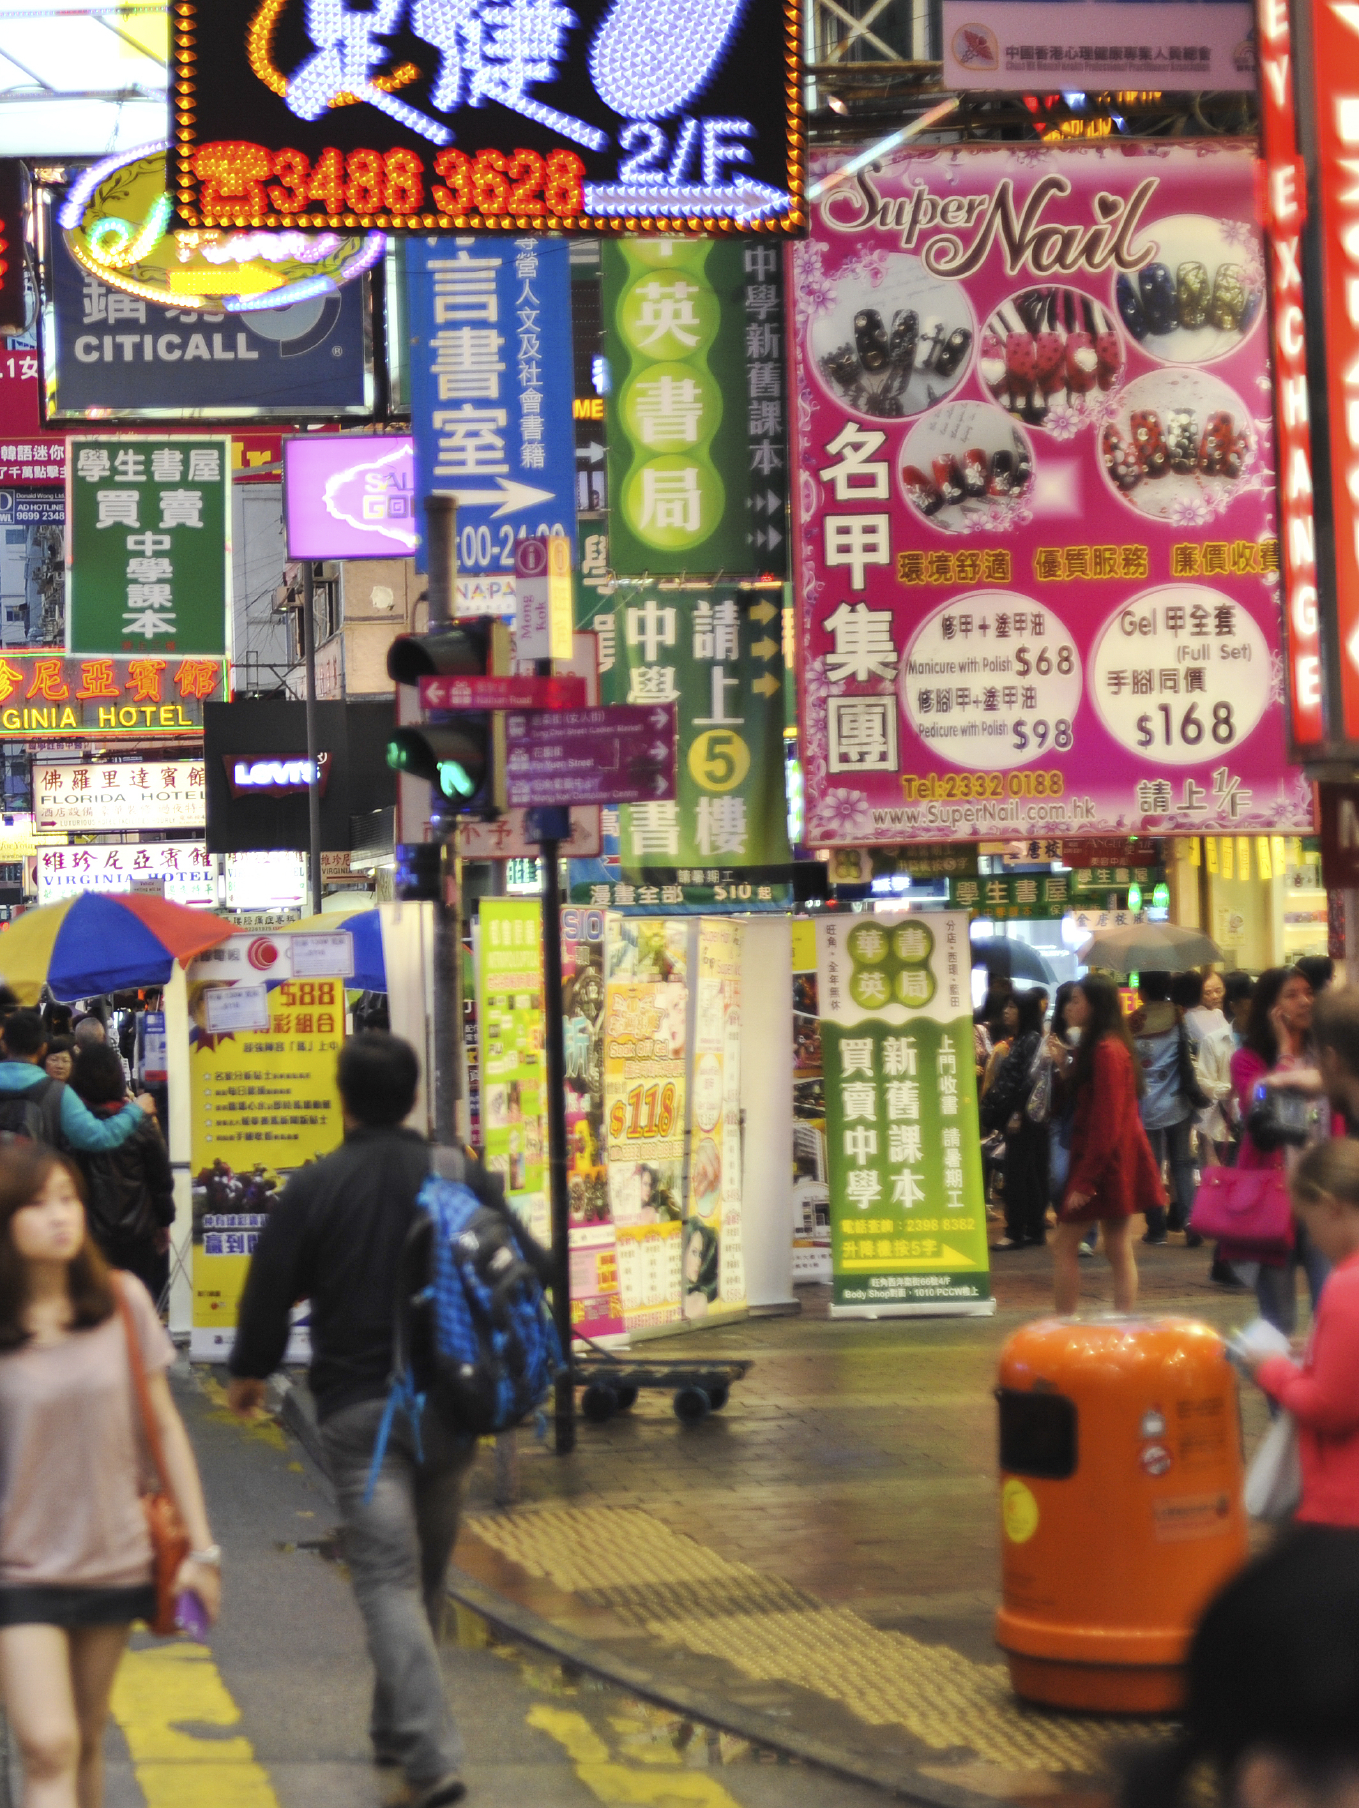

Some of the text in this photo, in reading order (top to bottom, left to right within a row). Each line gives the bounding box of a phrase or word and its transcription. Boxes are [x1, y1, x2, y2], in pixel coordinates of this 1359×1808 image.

[620, 117, 758, 186] 2/F
[271, 147, 586, 215] 3488 3628
[820, 160, 1162, 281] Super Nail
[74, 332, 259, 363] CITICALL
[634, 238, 706, 532] 英書局
[1274, 164, 1322, 708] EXCHANGE
[76, 448, 222, 483] 學生書屋
[16, 511, 65, 521] 9699 2348
[18, 503, 65, 511] AD HOTLINE
[95, 488, 205, 529] 買賣
[1033, 544, 1149, 581] 優質服務
[121, 530, 177, 639] 中學課本
[520, 594, 535, 640] Mong
[536, 601, 547, 632] Kok
[1119, 602, 1237, 639] Gel 甲全套
[908, 643, 1075, 678] Manicure with Polish $68
[1175, 641, 1253, 665] (Full Set)
[97, 704, 193, 728] HOTEL
[1136, 701, 1237, 749] $168
[918, 718, 1074, 753] Pedicure with Polish $98
[567, 757, 595, 769] Street
[40, 790, 206, 805] FLORIDA HOTEL
[1008, 769, 1064, 797] 0188
[871, 797, 1097, 829] www.SuperNail.com.hk
[43, 870, 215, 886] VIRGINIA HOTEL
[955, 877, 1070, 905] 學生書屋
[279, 981, 335, 1007] $88
[609, 1081, 677, 1139] $118
[906, 1218, 976, 1232] 2398 8382
[844, 1289, 867, 1299] Body
